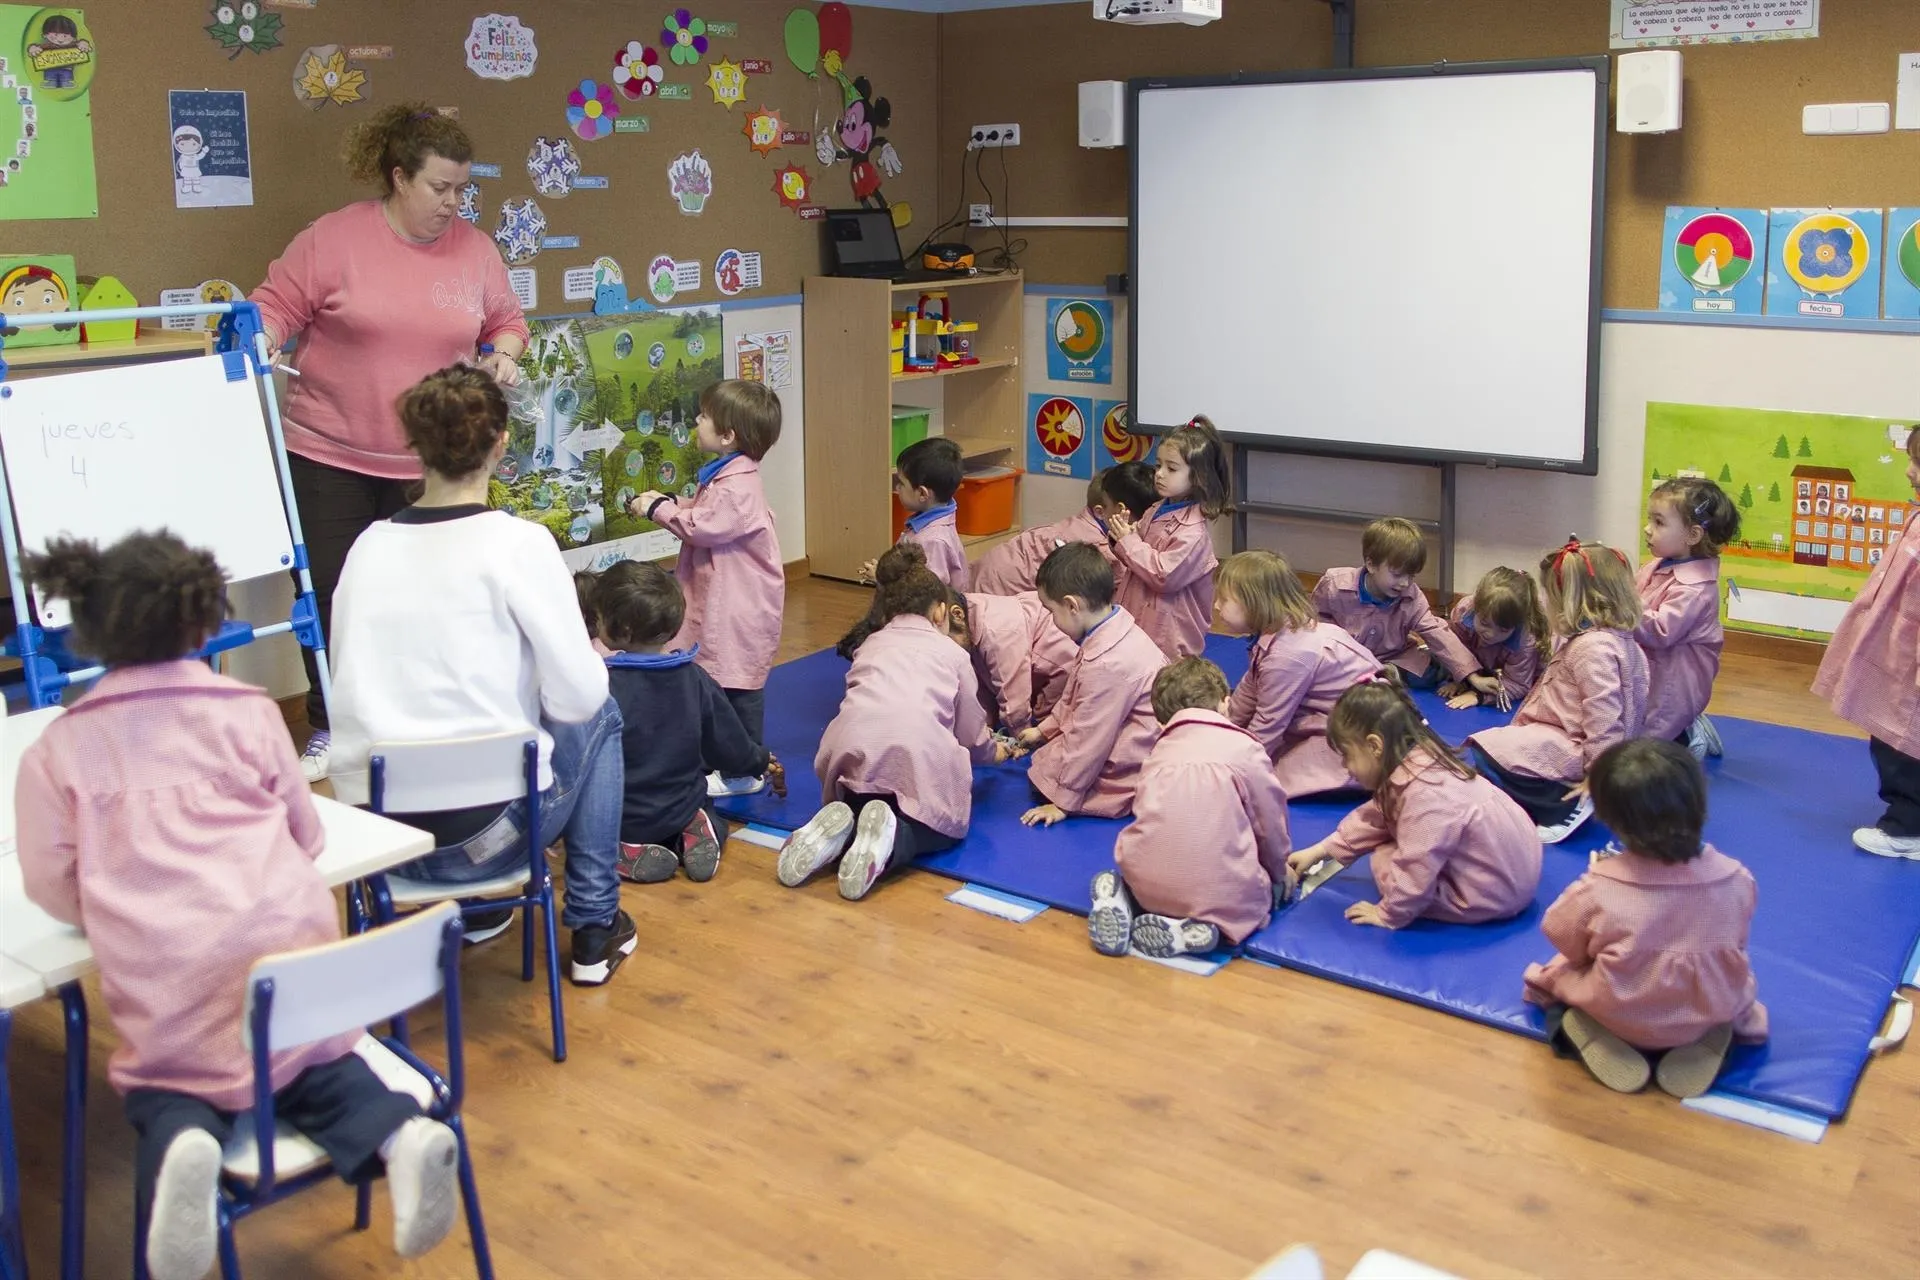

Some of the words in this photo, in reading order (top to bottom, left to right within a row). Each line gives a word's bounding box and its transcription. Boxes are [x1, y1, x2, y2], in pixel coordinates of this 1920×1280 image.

[1639, 8, 1673, 17] enseñanza
[1675, 8, 1688, 16] que
[1690, 6, 1706, 14] deja
[1763, 1, 1777, 9] que
[1632, 18, 1641, 26] de
[1643, 16, 1668, 25] cabeza
[1706, 13, 1720, 21] sino
[1722, 12, 1732, 20] de
[1734, 10, 1762, 19] corazón
[707, 23, 726, 35] mayo
[487, 27, 516, 49] Feliz
[349, 46, 379, 56] octubre
[471, 42, 533, 66] Cumpleaños
[743, 60, 759, 71] junio
[660, 85, 677, 96] abril
[615, 119, 639, 128] marzo
[782, 131, 796, 143] julio
[573, 176, 597, 185] febrero
[800, 207, 821, 219] agosto
[1706, 301, 1721, 309] hoy
[1809, 304, 1832, 313] fecha
[40, 412, 136, 459] jueves
[70, 455, 89, 489] 4
